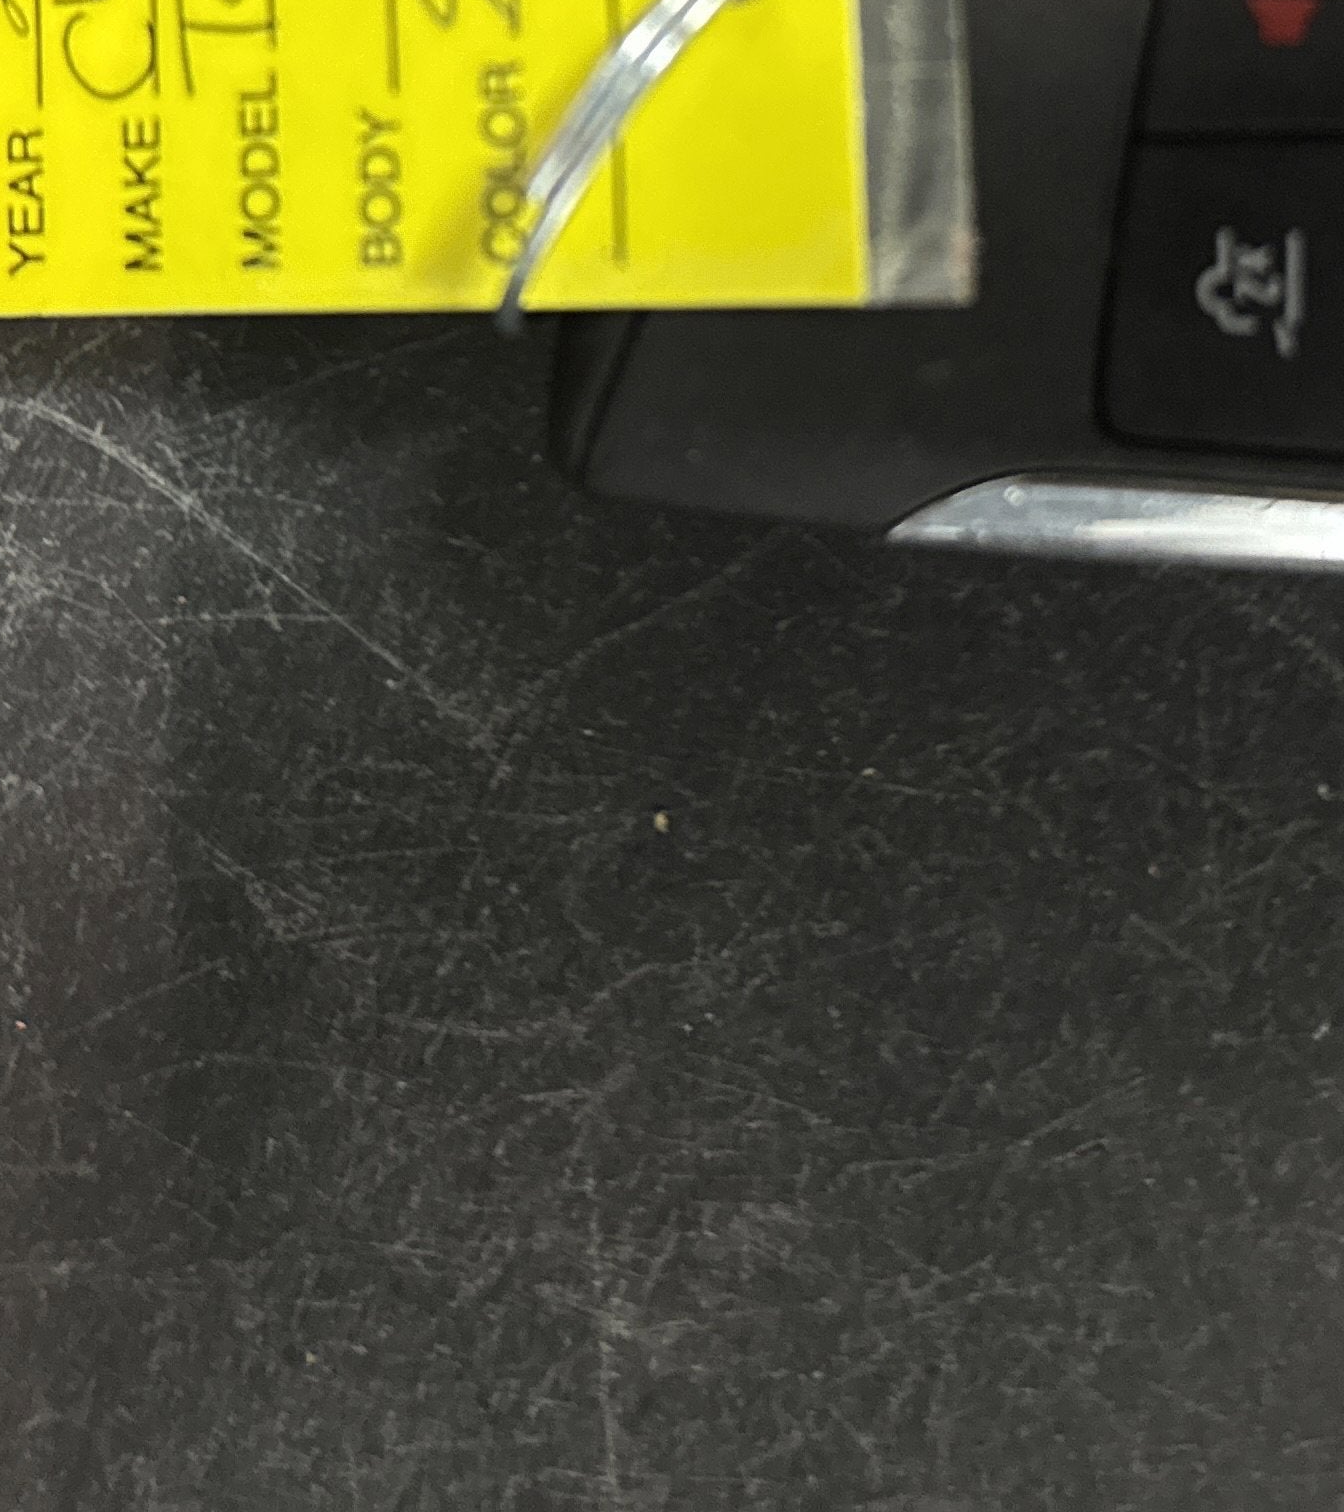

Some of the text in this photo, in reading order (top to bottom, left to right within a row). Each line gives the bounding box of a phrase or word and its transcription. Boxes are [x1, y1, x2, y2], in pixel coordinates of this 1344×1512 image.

[7, 128, 45, 276] YEAR
[123, 115, 163, 273] MAKE
[240, 80, 281, 269] MODEL
[360, 106, 403, 267] BODY
[479, 60, 527, 266] COLOR
